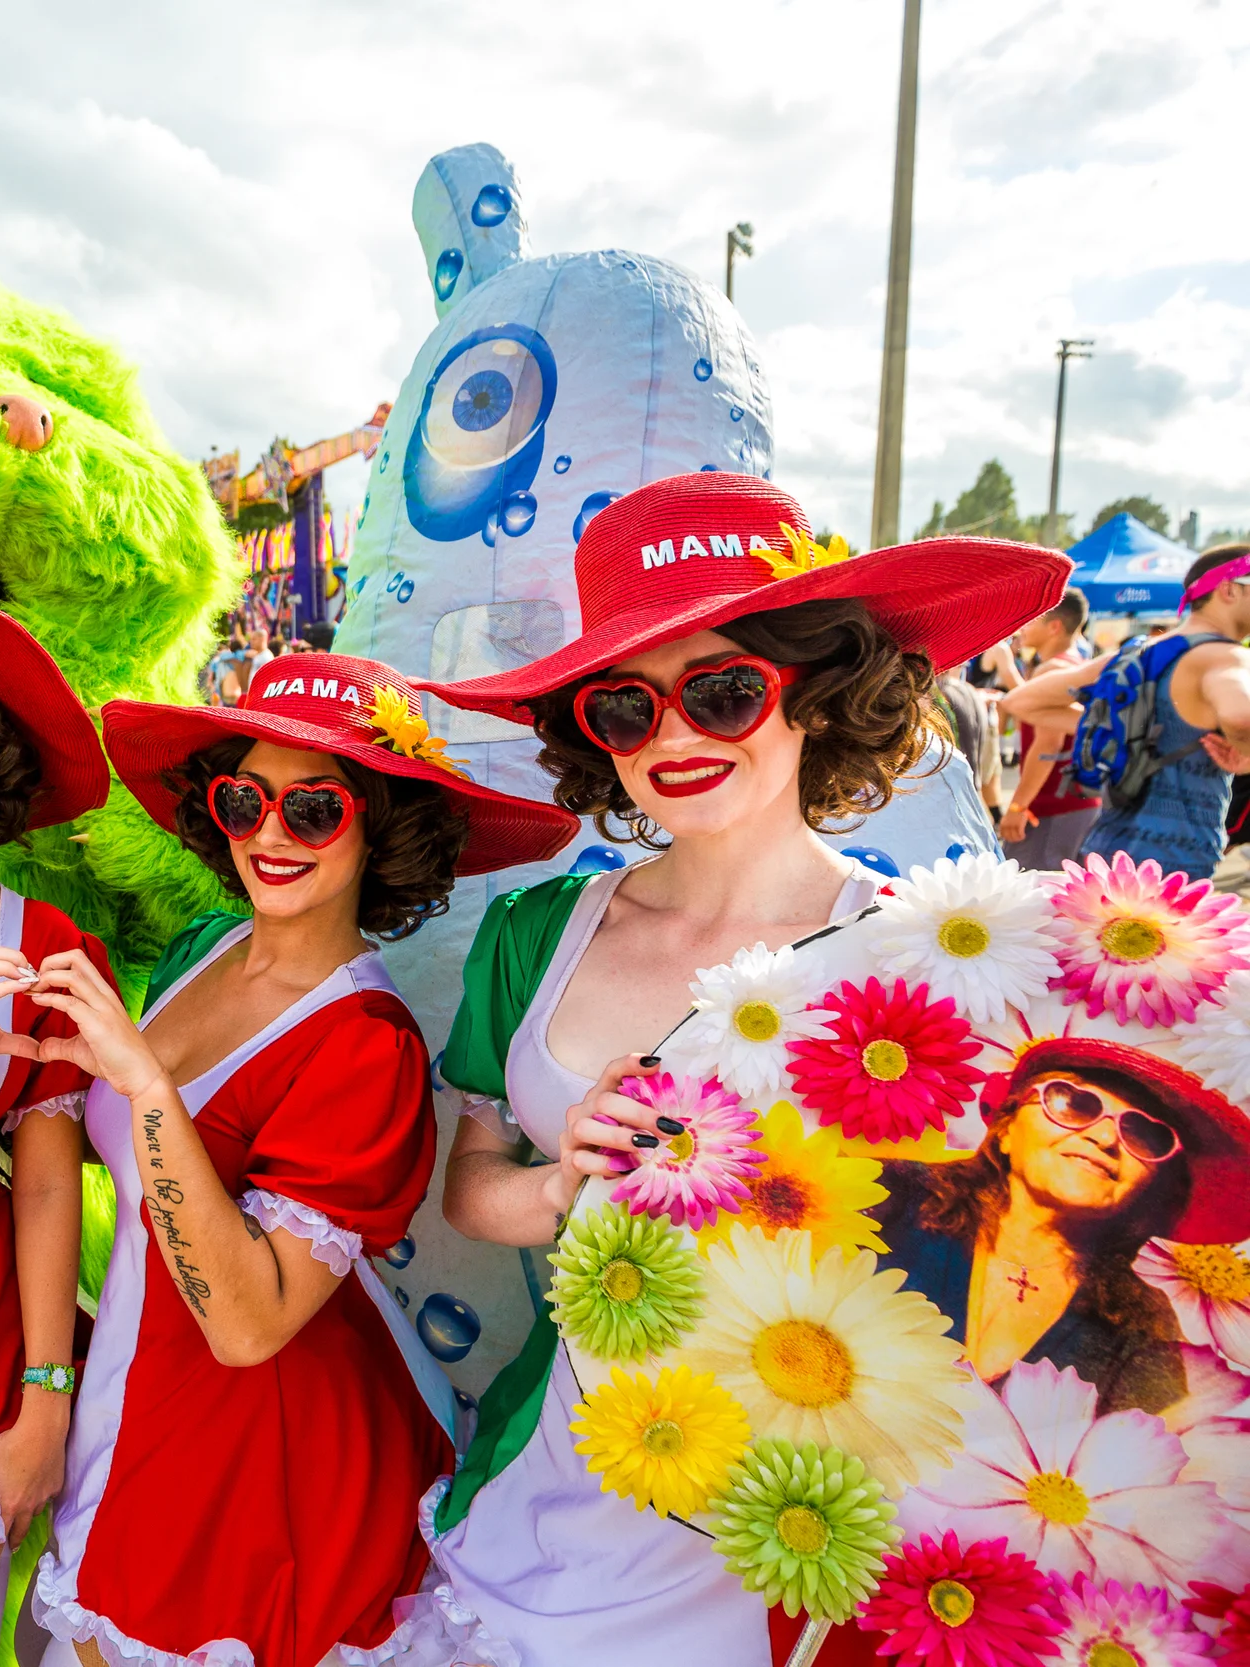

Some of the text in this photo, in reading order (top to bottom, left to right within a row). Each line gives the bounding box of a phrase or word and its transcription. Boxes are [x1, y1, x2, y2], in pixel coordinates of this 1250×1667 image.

[262, 678, 360, 706] MAMA
[143, 1109, 164, 1152] Music
[150, 1157, 164, 1169] is
[153, 1178, 184, 1205] the
[146, 1196, 191, 1251] perfect
